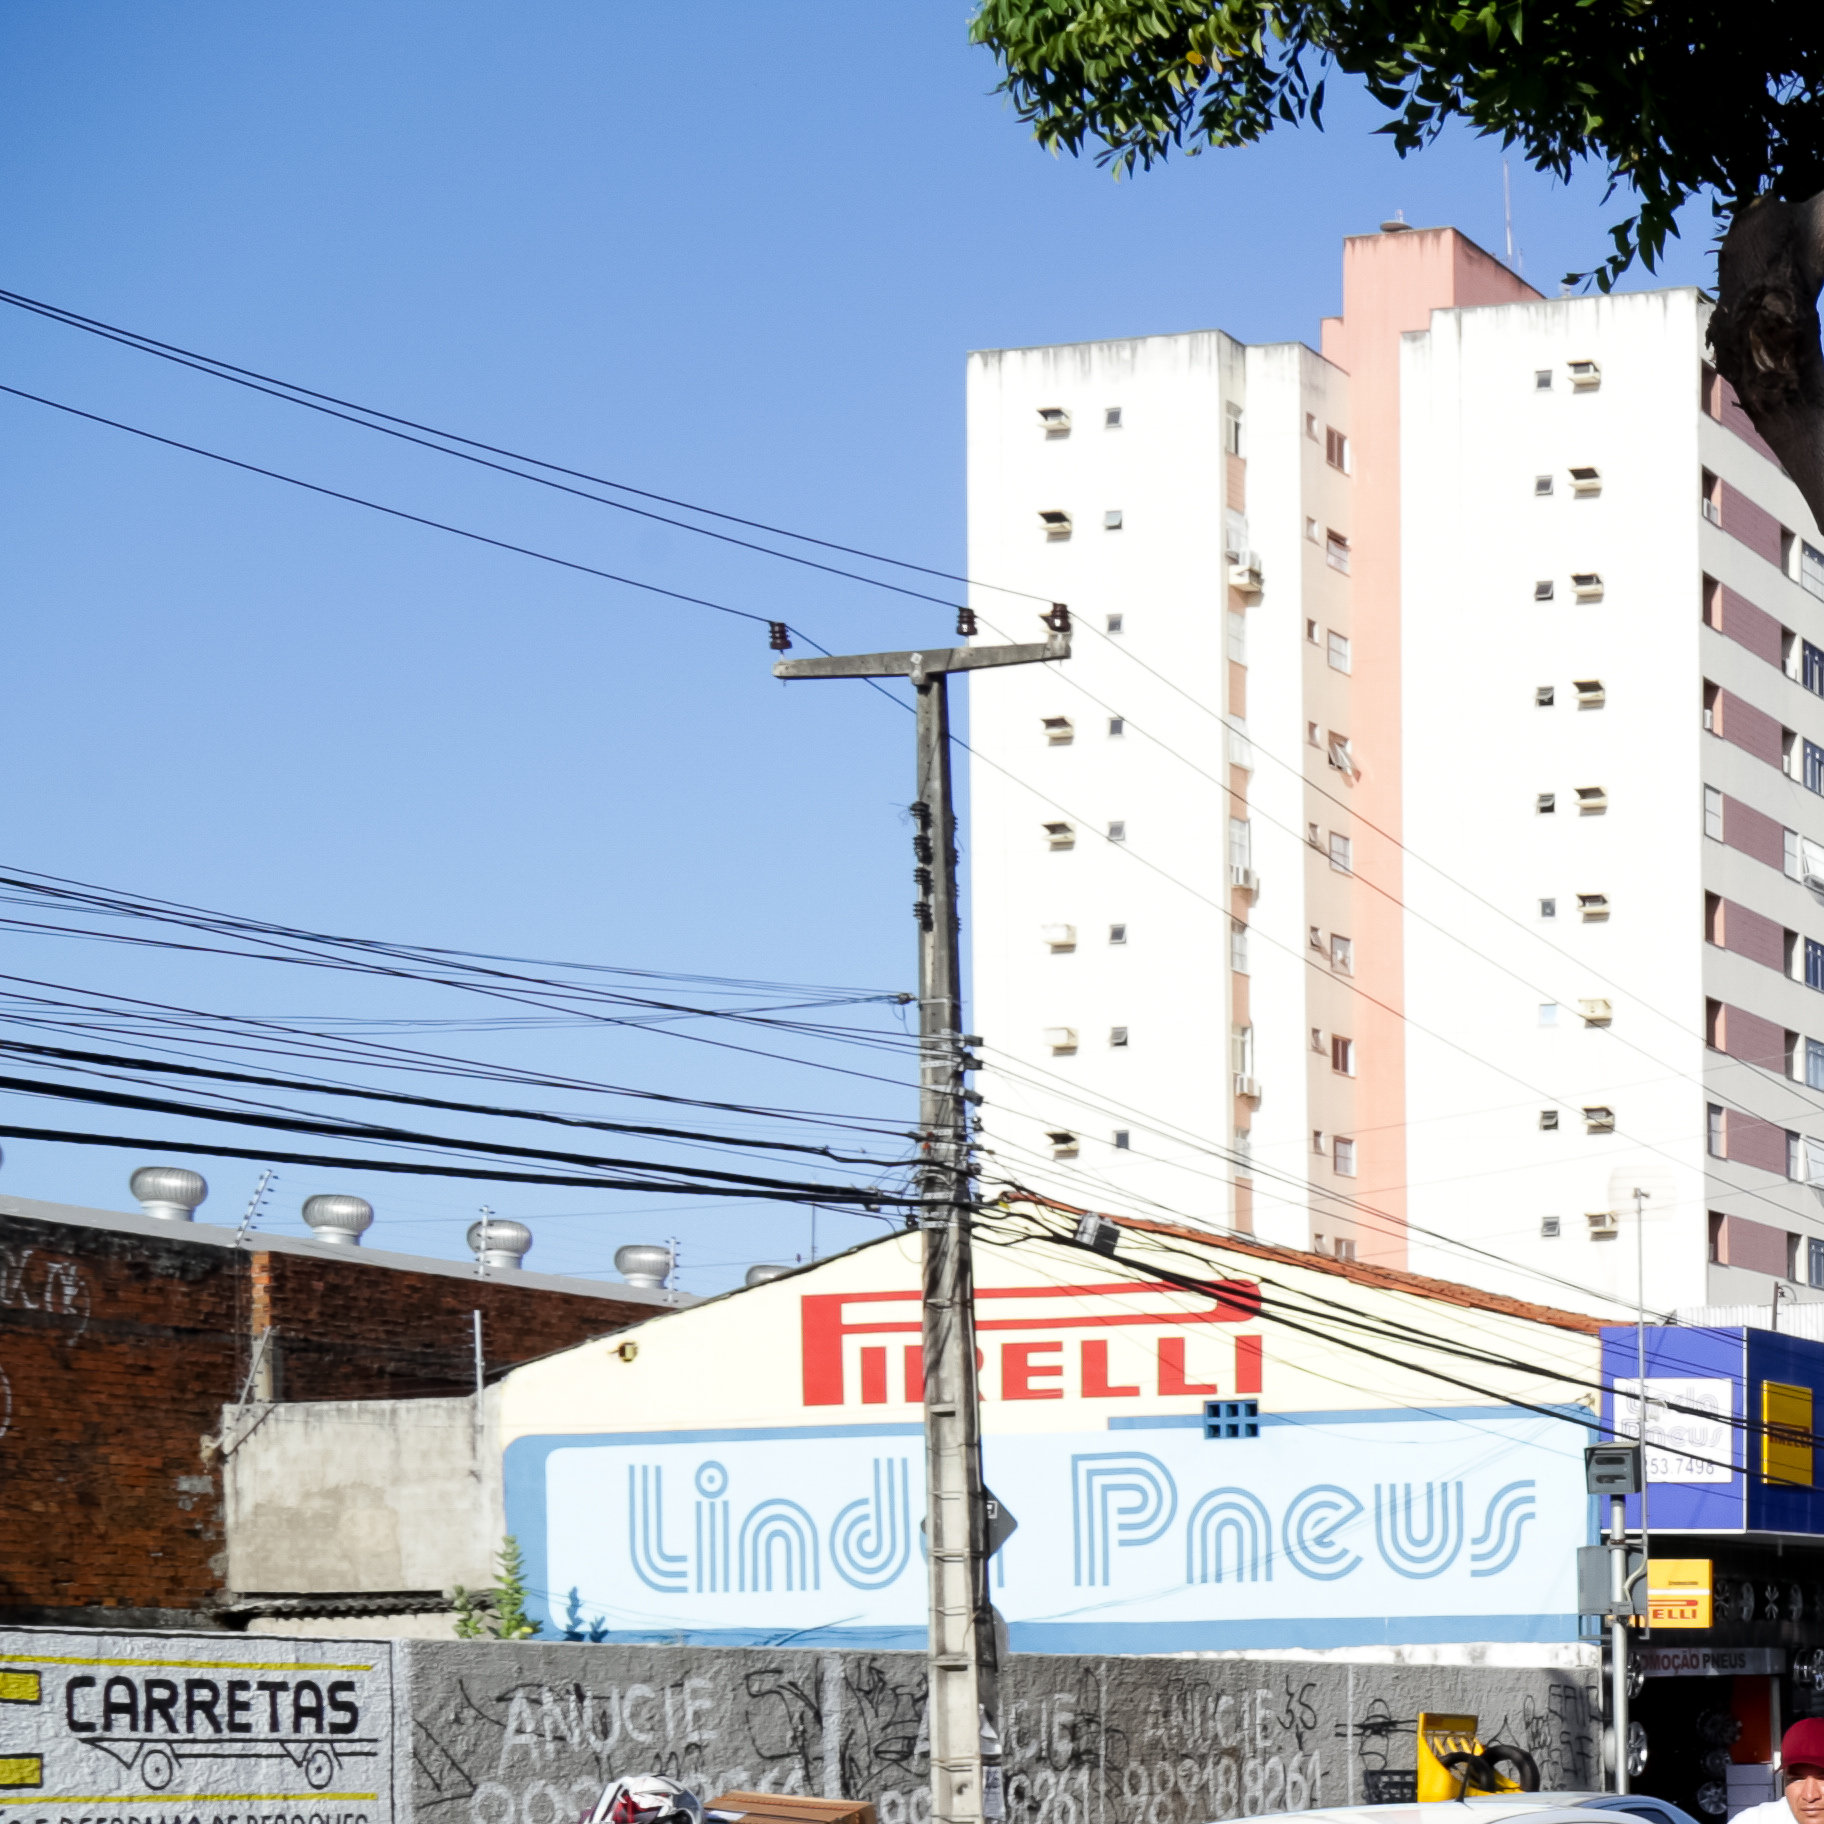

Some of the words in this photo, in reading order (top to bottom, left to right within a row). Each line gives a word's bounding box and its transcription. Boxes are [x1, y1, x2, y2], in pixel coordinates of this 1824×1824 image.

[1621, 1419, 1724, 1449] Pneus
[628, 1458, 1005, 1594] Lind
[1071, 1451, 1537, 1588] Pneus
[1702, 1653, 1747, 1670] PNEUS
[66, 1675, 360, 1735] CARRETAS
